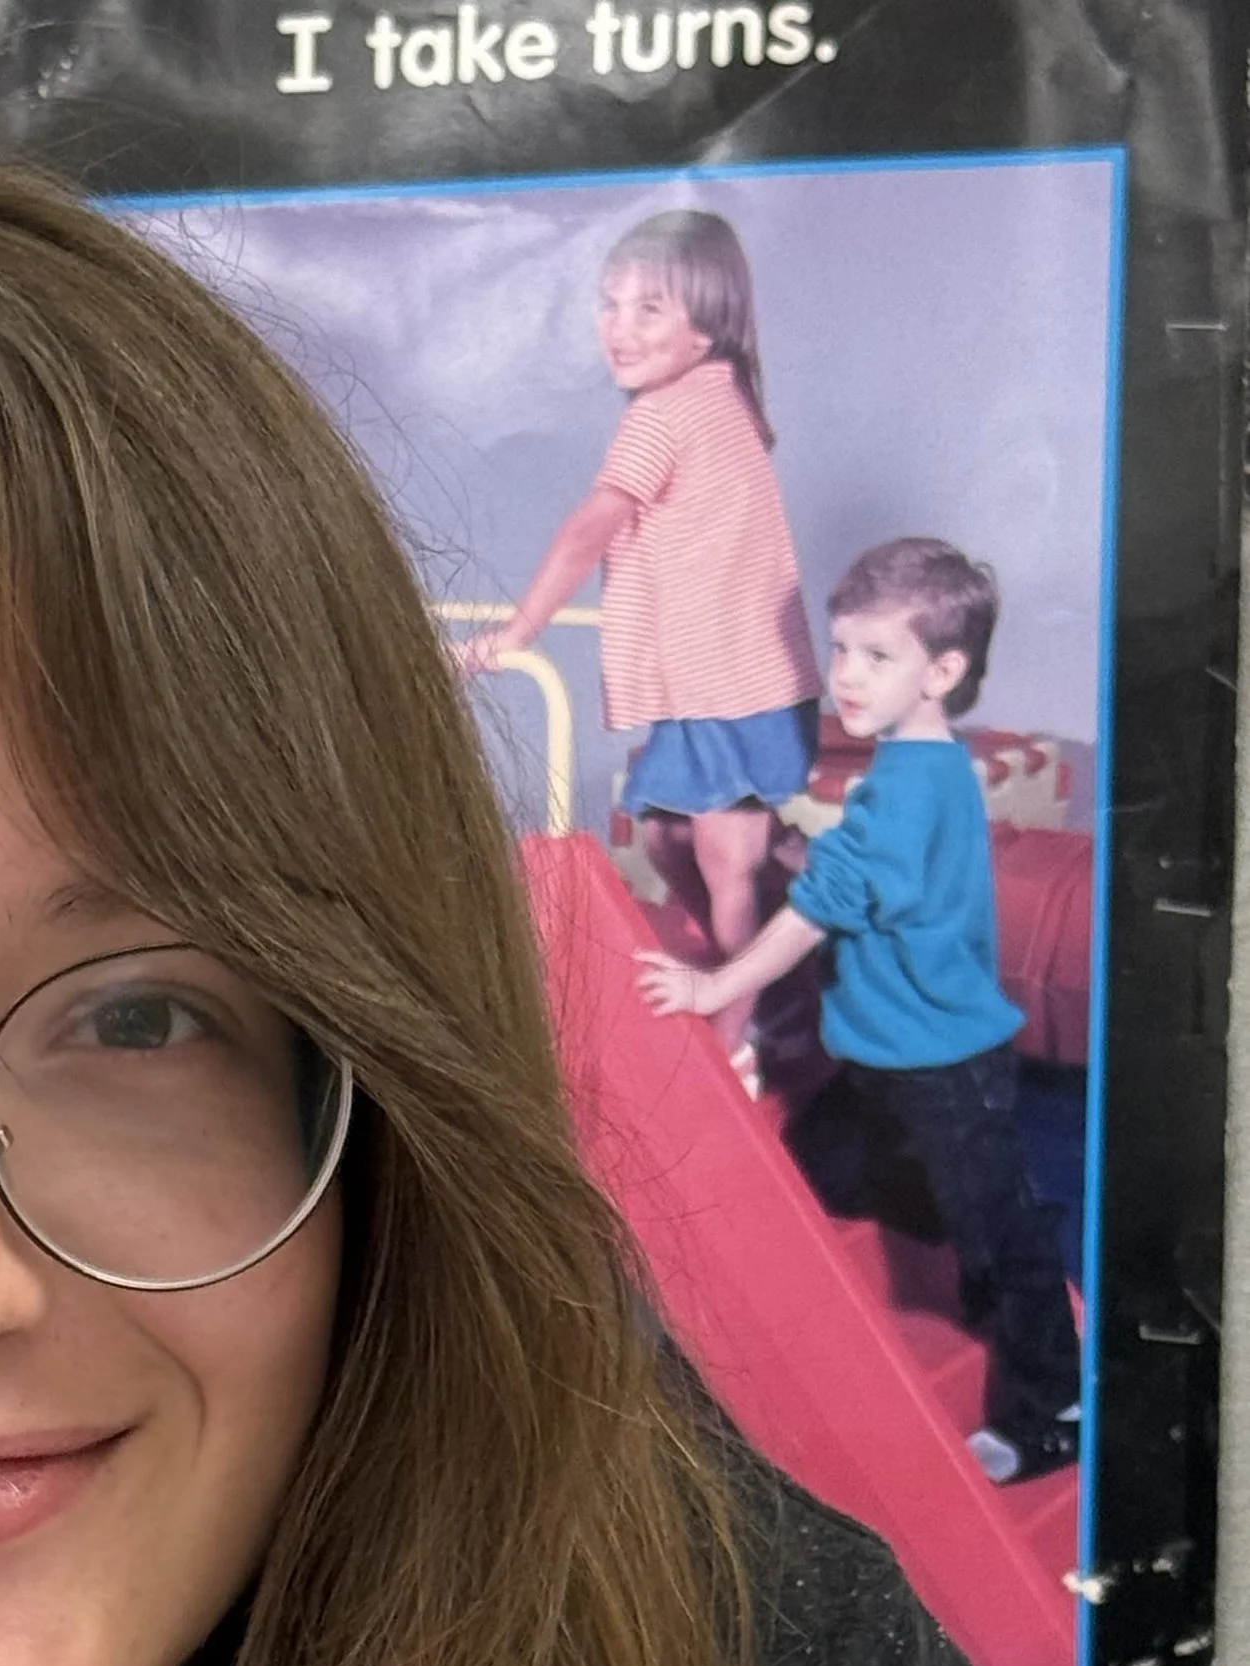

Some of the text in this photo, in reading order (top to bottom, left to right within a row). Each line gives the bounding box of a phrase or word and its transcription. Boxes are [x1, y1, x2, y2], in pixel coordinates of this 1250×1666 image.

[276, 0, 838, 93] I take turns.
